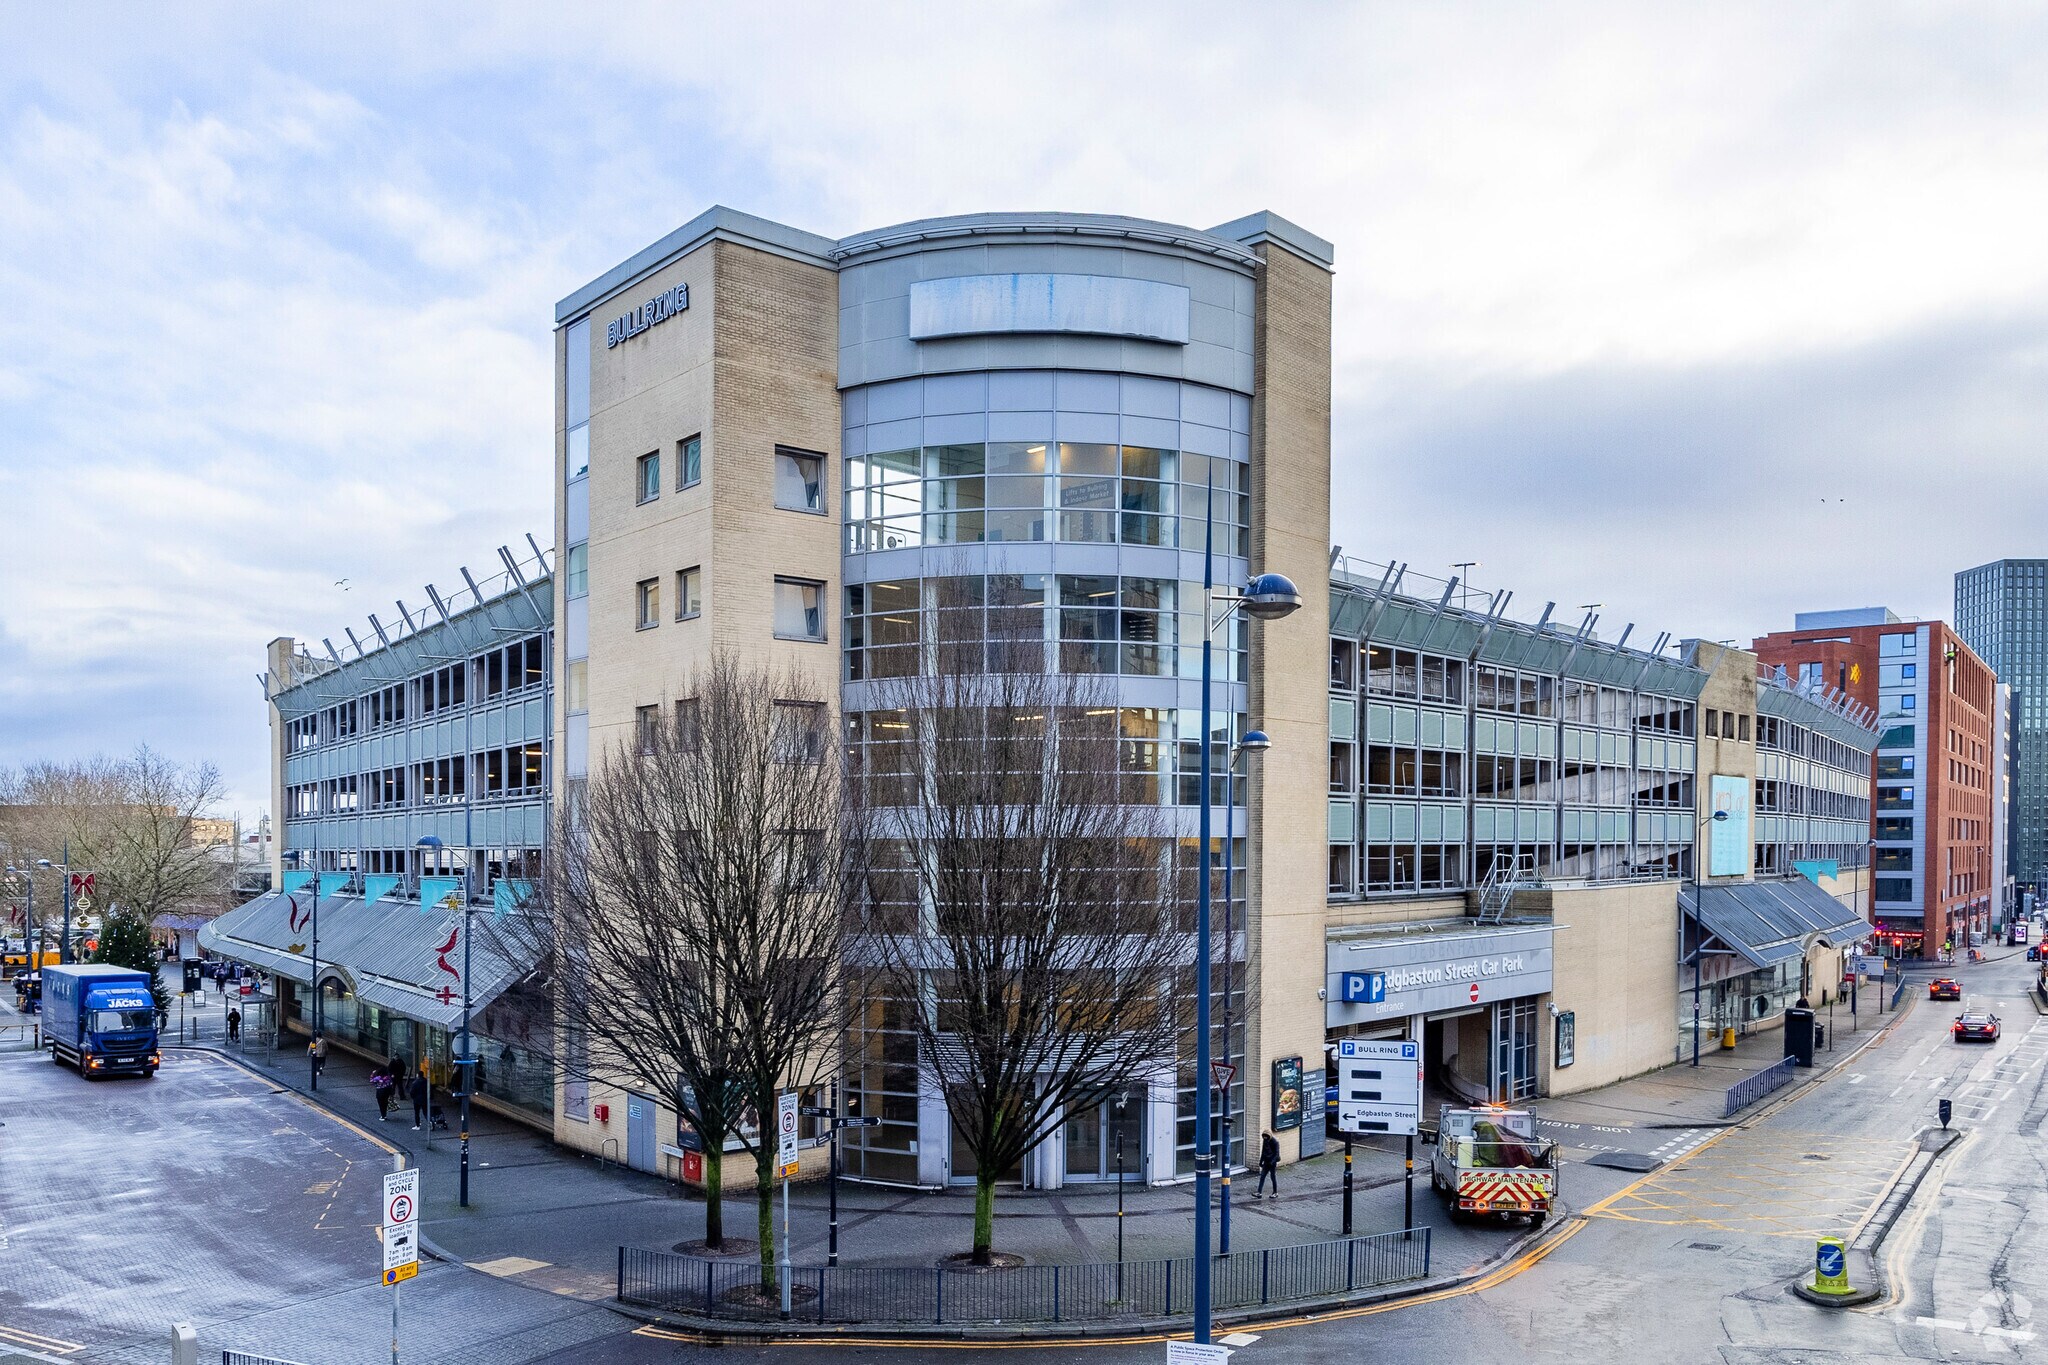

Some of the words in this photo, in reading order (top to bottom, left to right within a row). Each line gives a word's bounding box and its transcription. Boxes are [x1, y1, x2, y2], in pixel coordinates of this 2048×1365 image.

[607, 282, 689, 349] BULLRING
[1445, 960, 1478, 981] Street
[1481, 958, 1498, 976] Car
[1502, 954, 1523, 973] Park
[107, 998, 144, 1008] JACKS
[1376, 1002, 1405, 1014] Entrance
[782, 1103, 794, 1111] ZONE
[1592, 1126, 1632, 1134] LOOK
[1578, 1142, 1628, 1152] LEFT
[386, 1170, 418, 1181] PEDESTRIAN
[398, 1176, 414, 1184] CYCLE
[390, 1183, 412, 1195] ZONE
